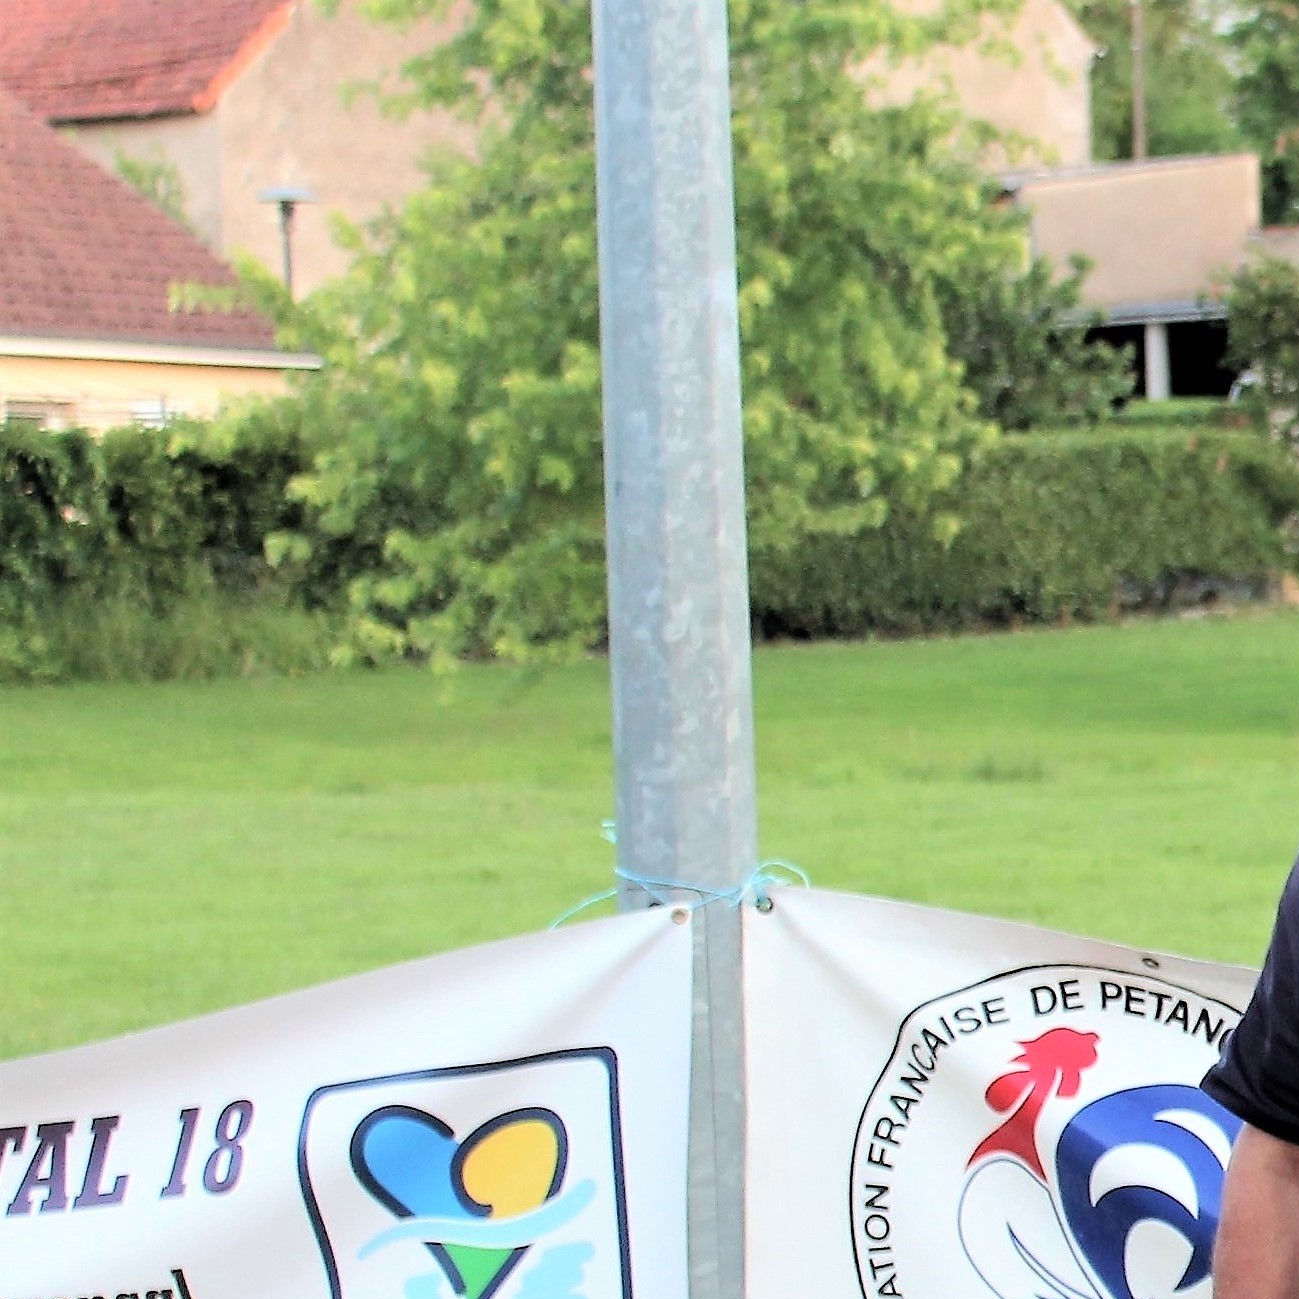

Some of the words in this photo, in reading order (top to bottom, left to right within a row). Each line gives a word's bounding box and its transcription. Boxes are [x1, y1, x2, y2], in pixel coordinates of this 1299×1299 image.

[160, 1099, 254, 1198] 18
[867, 996, 1010, 1173] FRANCAISE
[1030, 979, 1083, 1018] DE
